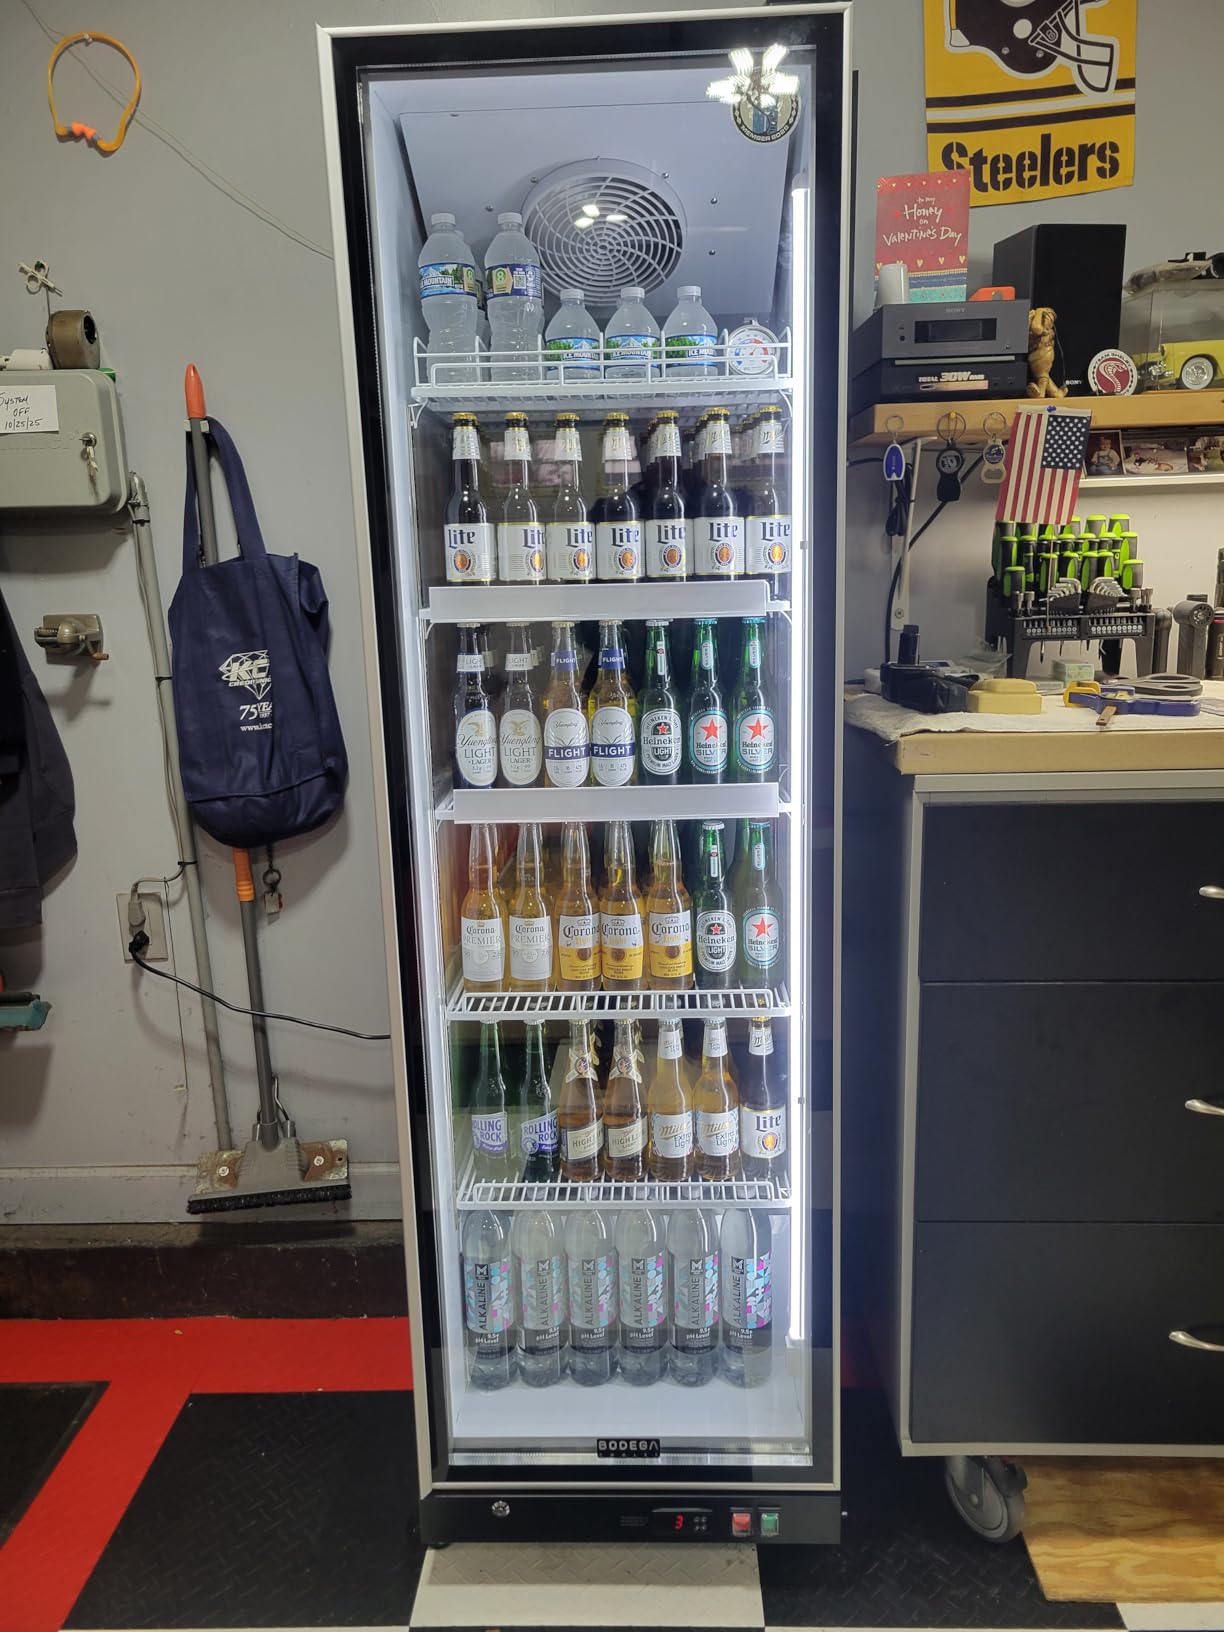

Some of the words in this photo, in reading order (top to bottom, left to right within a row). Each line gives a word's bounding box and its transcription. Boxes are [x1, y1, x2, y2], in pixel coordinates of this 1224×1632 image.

[942, 133, 1119, 193] Steelers
[904, 203, 943, 224] Honey
[882, 226, 938, 247] Valentine's
[940, 226, 962, 247] Day
[13, 406, 30, 417] OFF
[5, 416, 44, 430] 10/25/25
[448, 529, 476, 549] Lite
[565, 527, 593, 549] Lite
[610, 527, 639, 547] Lite
[656, 524, 686, 544] Lite
[708, 522, 738, 542] Lite
[760, 521, 791, 541] Lite
[602, 655, 623, 663] FLIGHT
[240, 704, 258, 720] 75
[464, 747, 496, 758] LIGHT
[504, 746, 537, 757] LIGHT
[548, 746, 587, 758] FLIGHT
[593, 745, 632, 756] FLIGHT
[466, 924, 495, 935] Corona
[515, 923, 545, 934] Corona
[602, 922, 638, 937] Corona
[651, 921, 690, 936] Corona
[523, 1116, 558, 1135] ROLLING
[755, 1114, 782, 1132] Lite
[480, 1131, 503, 1142] ROCK
[477, 1281, 487, 1331] ALKALINE
[538, 1278, 548, 1327] ALKALINE
[583, 1278, 593, 1326] ALKALINE
[632, 1277, 643, 1326] ALKALINE
[690, 1277, 700, 1326] ALKALINE
[733, 1275, 743, 1327] ALKALINE
[598, 1440, 659, 1451] BODEGA
[675, 1514, 684, 1531] 3
